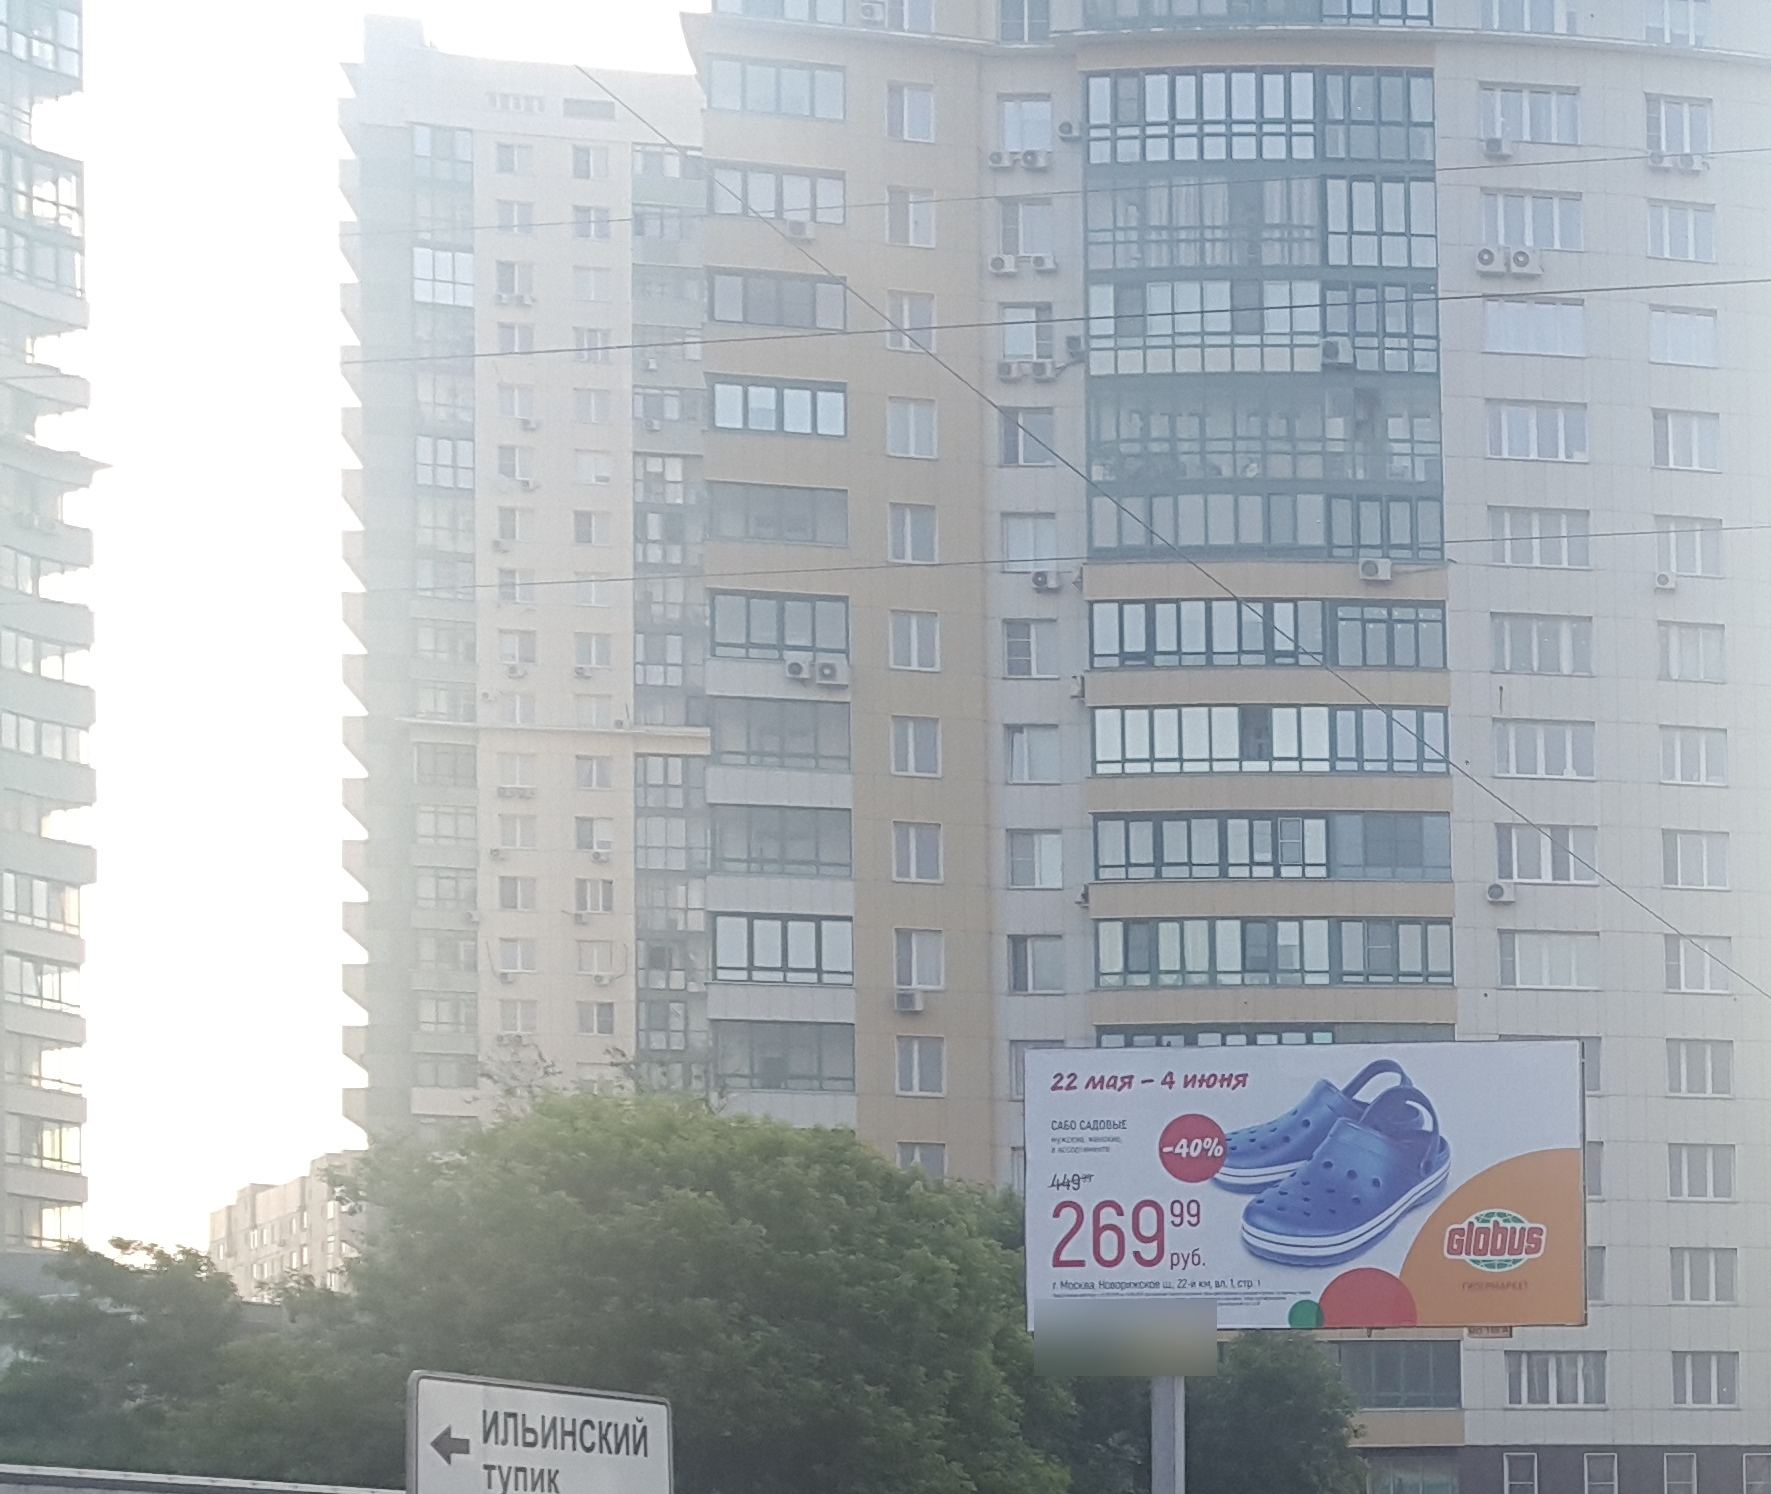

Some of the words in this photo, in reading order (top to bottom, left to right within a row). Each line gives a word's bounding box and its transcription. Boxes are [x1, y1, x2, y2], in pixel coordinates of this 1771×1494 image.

[1050, 1072, 1078, 1092] 22
[1085, 1074, 1135, 1092] мая
[1160, 1071, 1176, 1089] 4
[1183, 1073, 1249, 1091] июня
[1051, 1120, 1077, 1131] САБО
[1079, 1119, 1128, 1131] САДОВЫЕ
[1162, 1138, 1224, 1158] -40%
[1050, 1173, 1081, 1191] 449
[1052, 1200, 1165, 1268] 269
[1170, 1199, 1201, 1228] 99
[1447, 1220, 1544, 1257] Globus
[1170, 1248, 1206, 1270] руб.
[482, 1409, 648, 1458] ИЛЬИНСКИЙ
